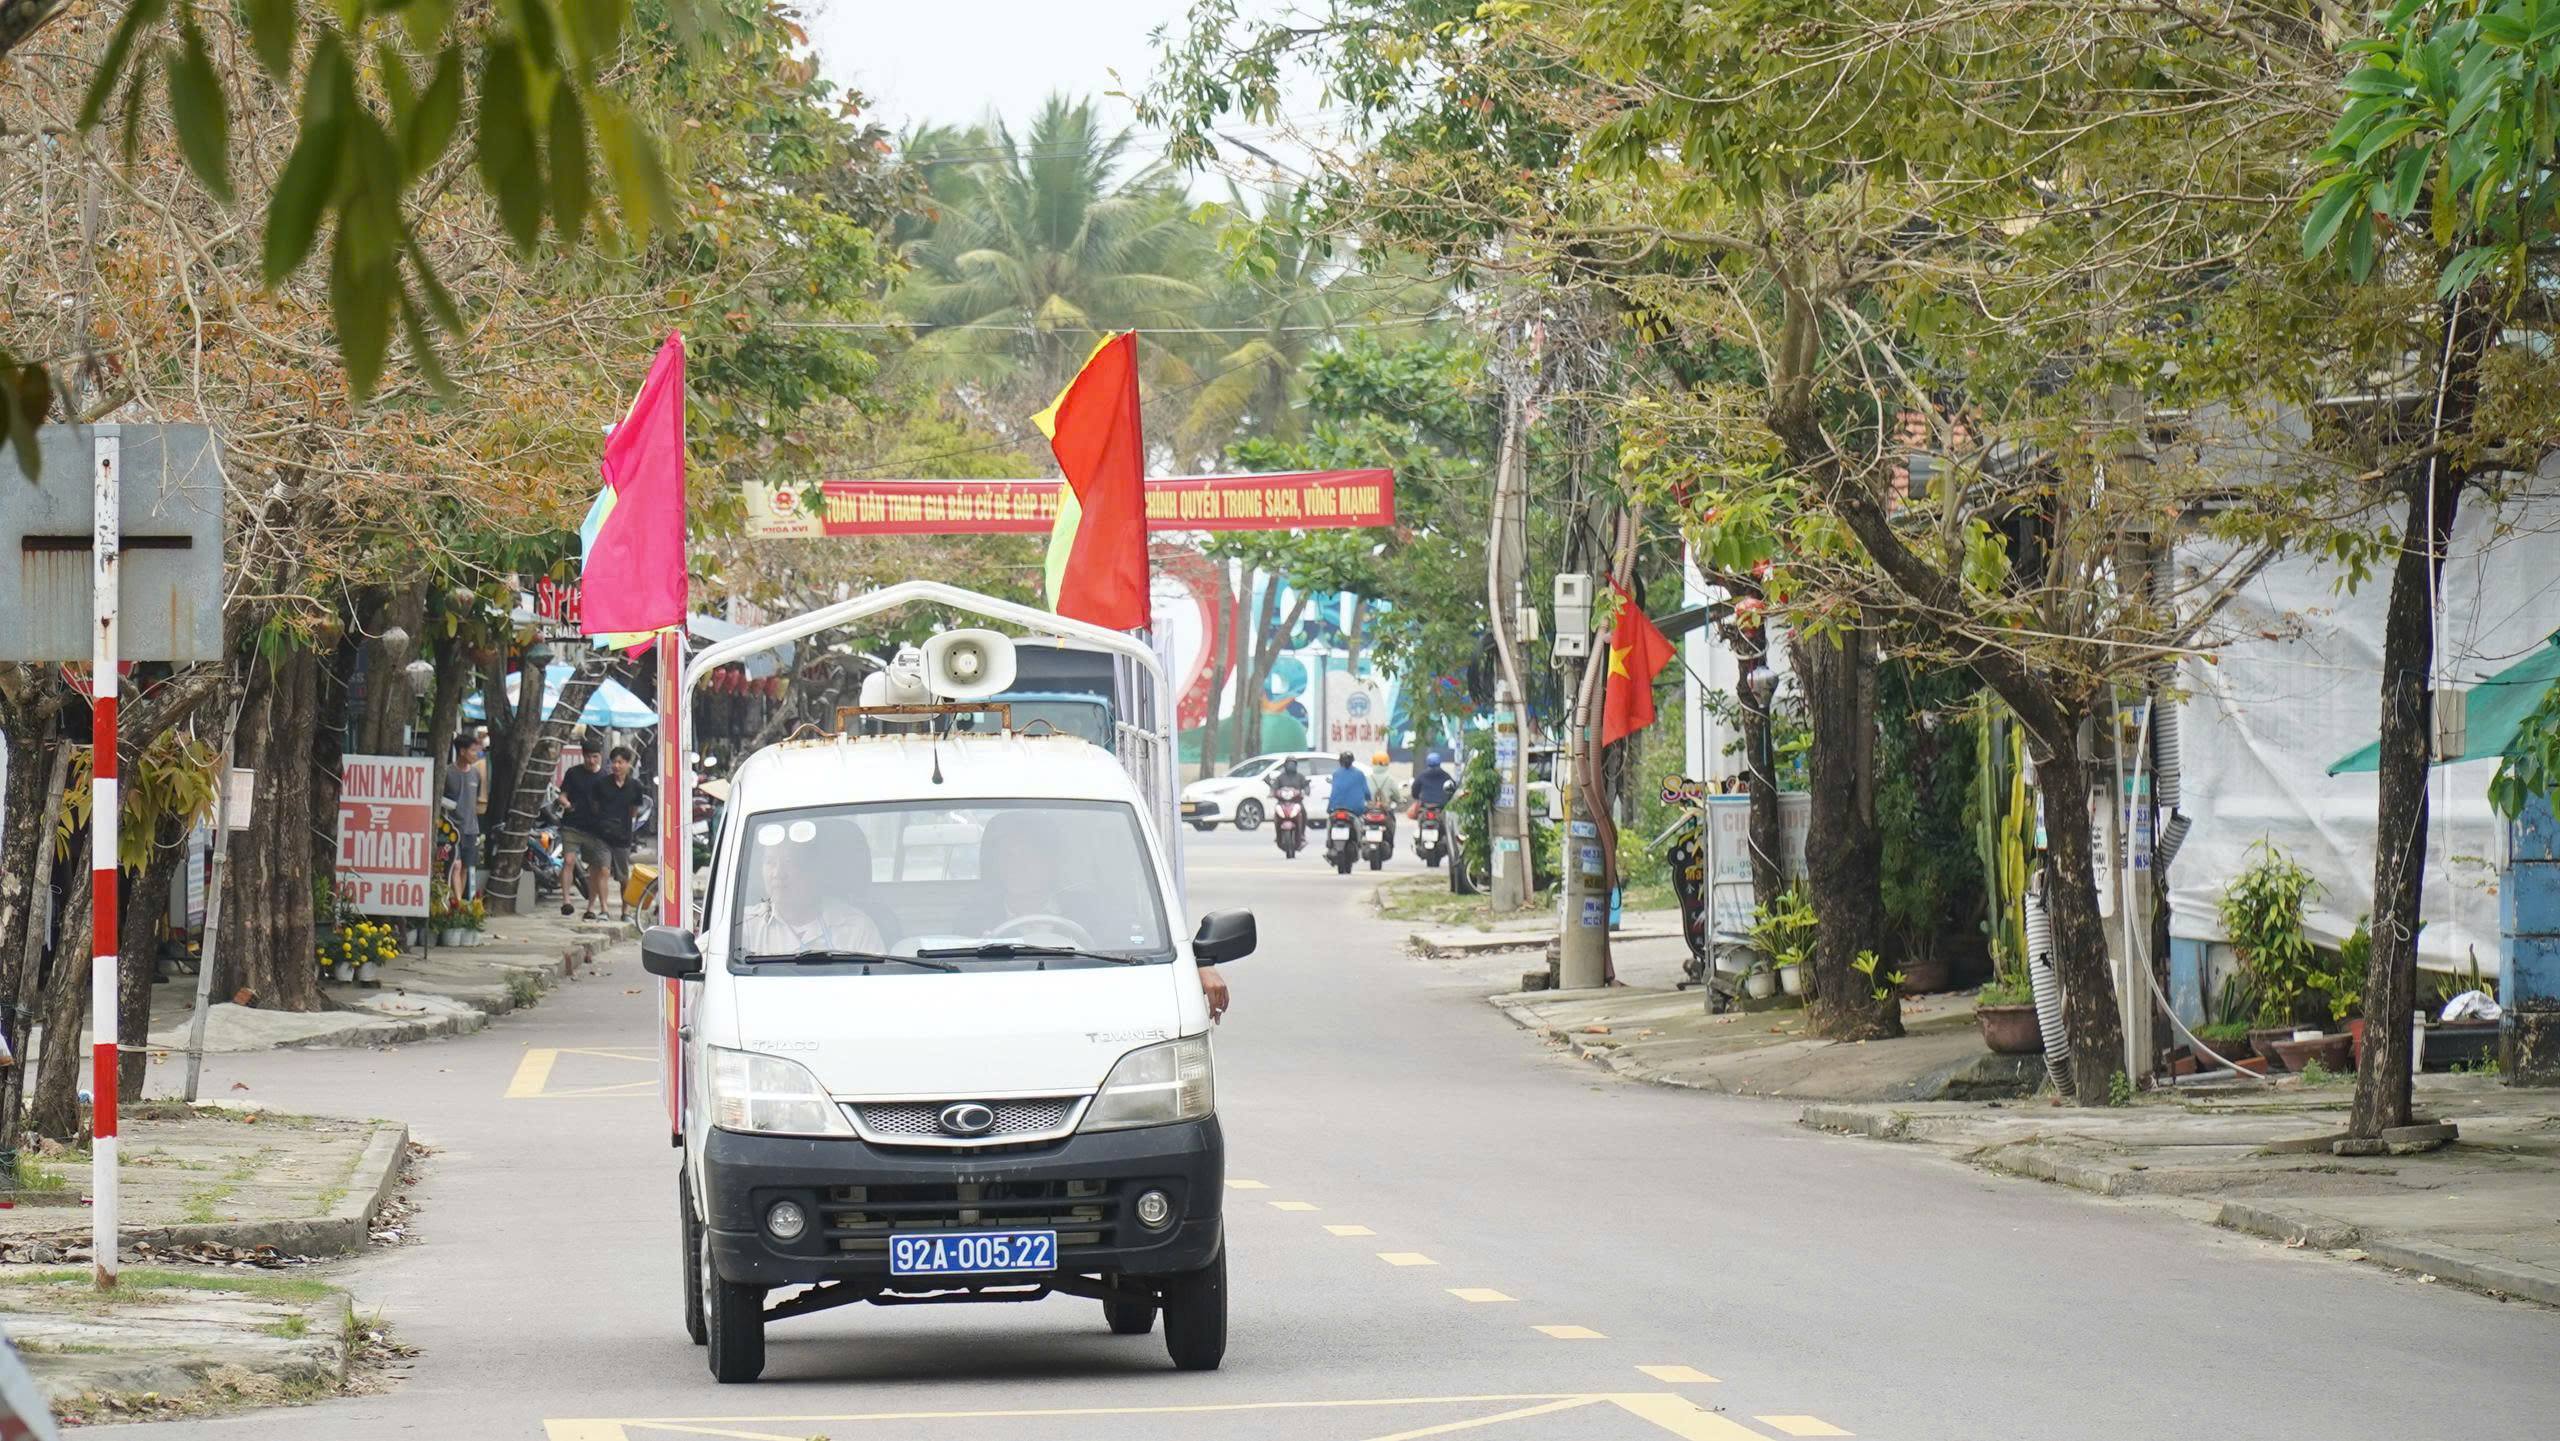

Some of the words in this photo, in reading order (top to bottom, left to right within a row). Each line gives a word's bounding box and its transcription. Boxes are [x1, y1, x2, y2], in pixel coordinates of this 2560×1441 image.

[887, 494, 922, 522] THAM
[925, 494, 946, 521] GIA
[1013, 488, 1038, 520] GÓP
[1222, 488, 1263, 519] TRONG
[1265, 488, 1302, 523] SẠCH,
[341, 764, 375, 797] MINI
[380, 765, 425, 799] MART
[337, 809, 424, 869] EMART
[381, 879, 424, 907] HÓA
[752, 1039, 819, 1051] THACO
[1086, 1029, 1169, 1043] TOWNER
[896, 1236, 1051, 1271] 92A-005.22
